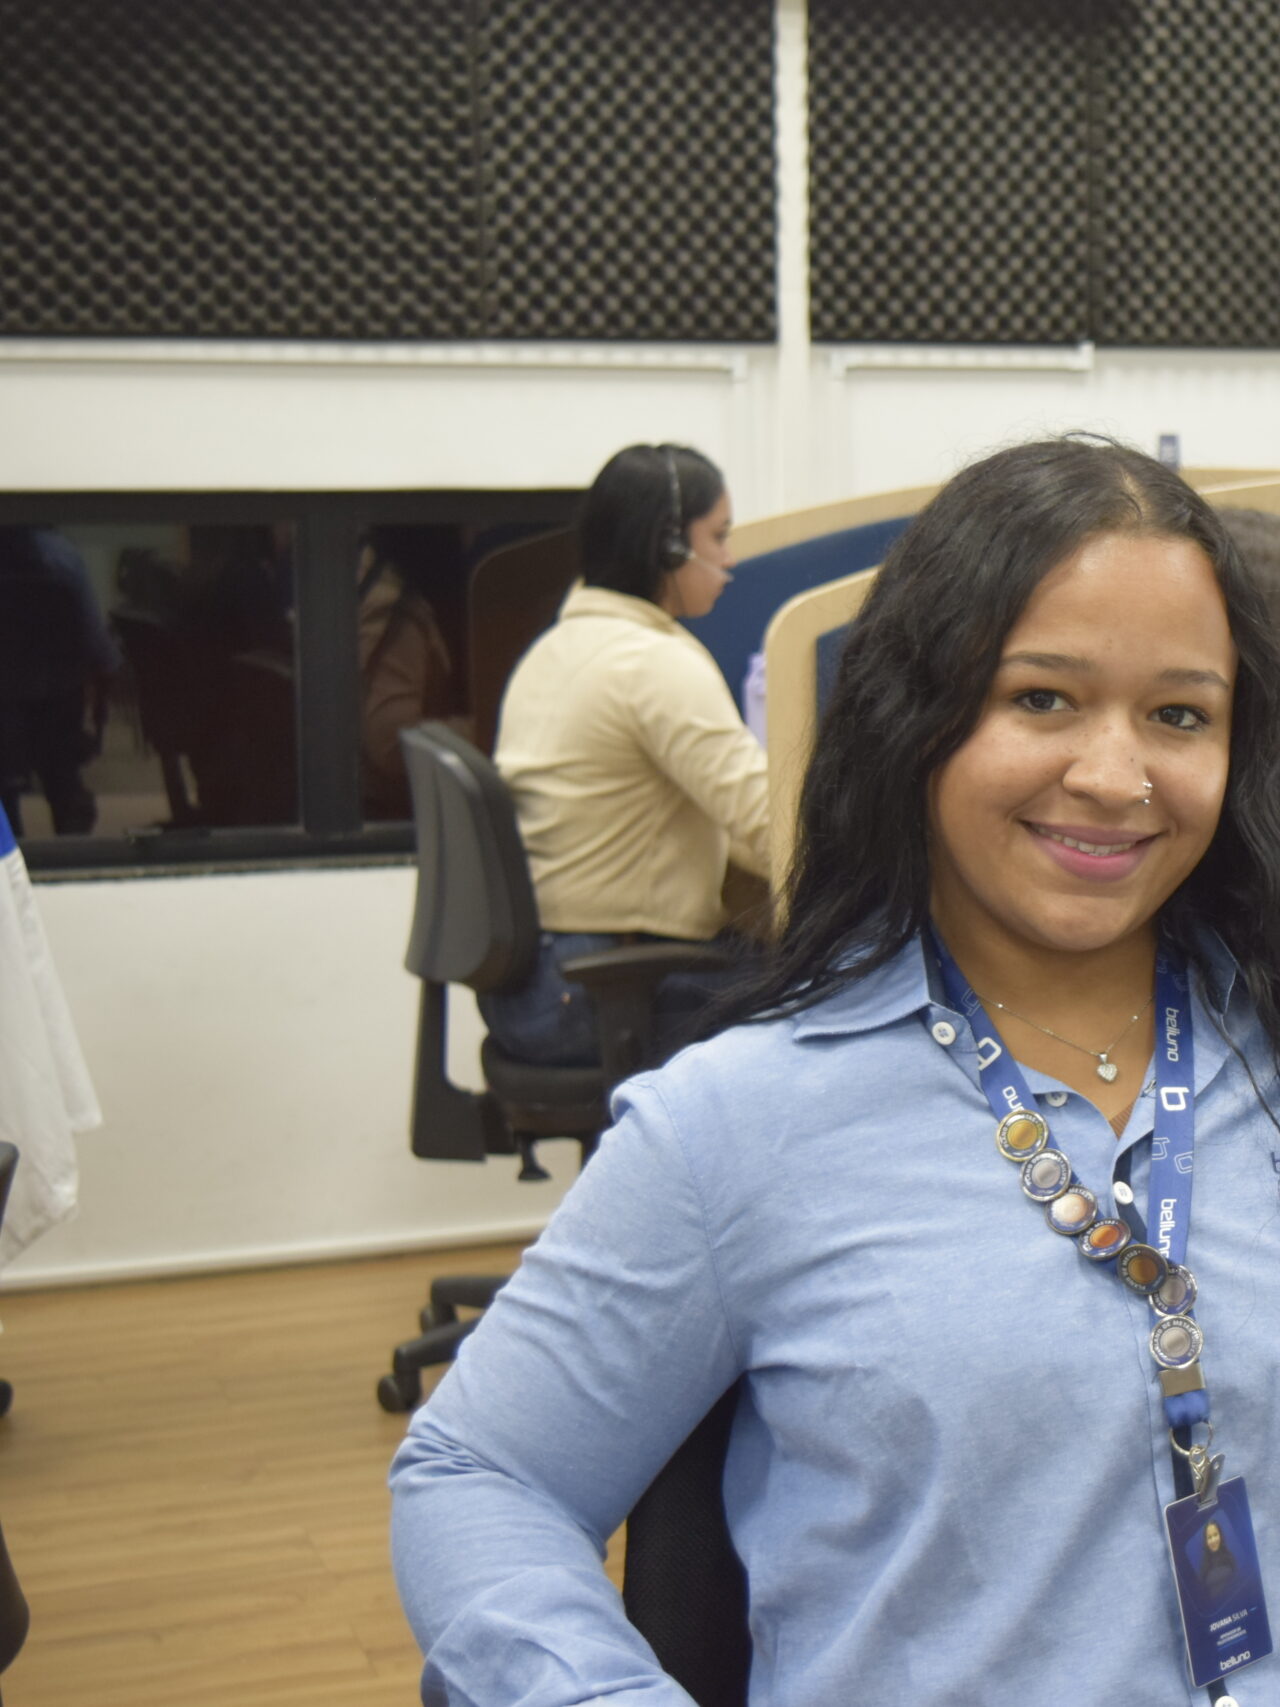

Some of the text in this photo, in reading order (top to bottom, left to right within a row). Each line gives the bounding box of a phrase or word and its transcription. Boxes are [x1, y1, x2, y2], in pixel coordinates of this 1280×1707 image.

[1165, 1007, 1180, 1062] belluno
[1158, 1199, 1177, 1258] bellun
[1220, 1650, 1251, 1671] belluno
